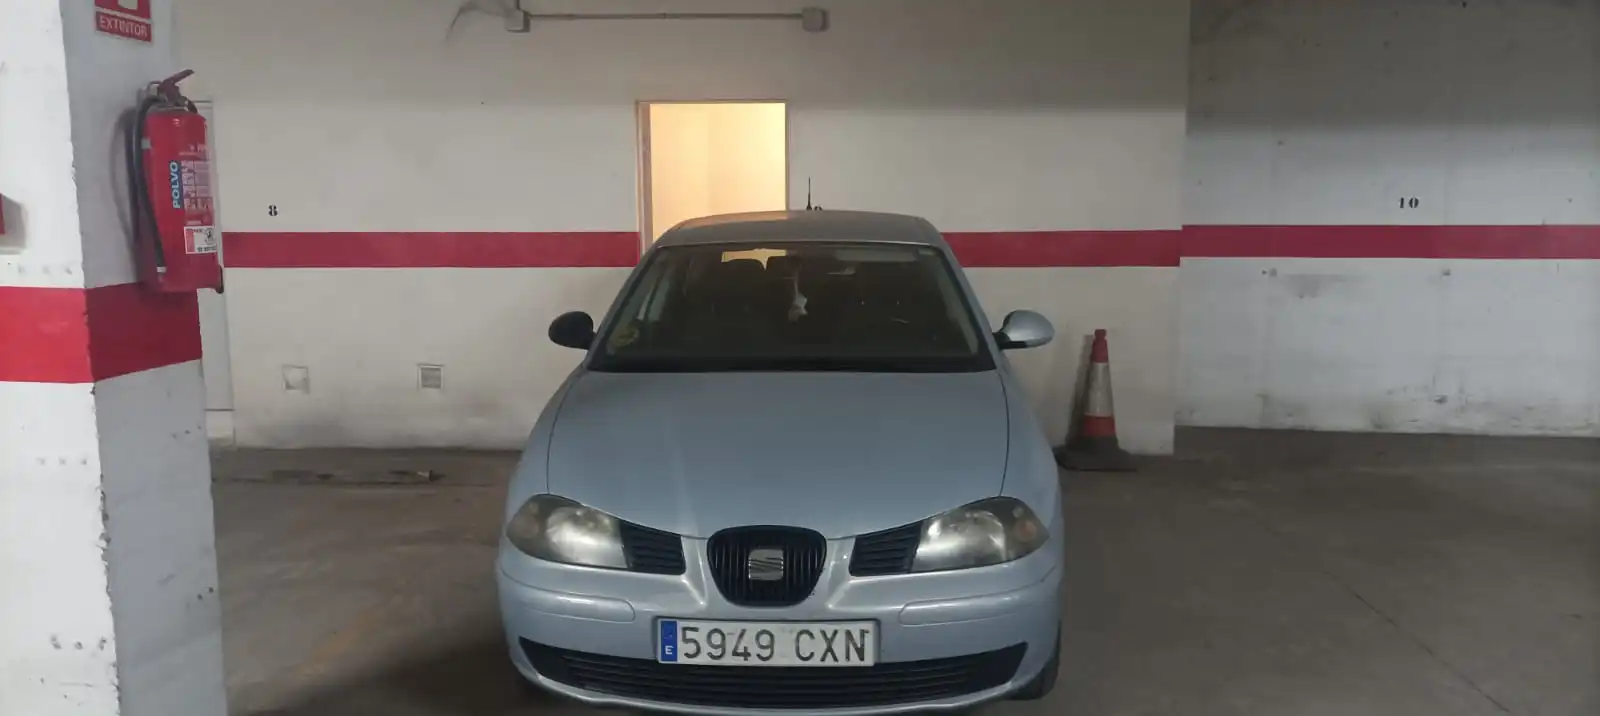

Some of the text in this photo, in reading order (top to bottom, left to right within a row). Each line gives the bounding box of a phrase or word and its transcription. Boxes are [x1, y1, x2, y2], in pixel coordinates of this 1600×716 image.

[100, 15, 148, 38] EXTINTOR
[169, 161, 180, 209] POLVO
[268, 204, 278, 217] 8
[1399, 197, 1420, 209] 10
[664, 645, 673, 655] E
[681, 626, 870, 663] 5949 CXN
